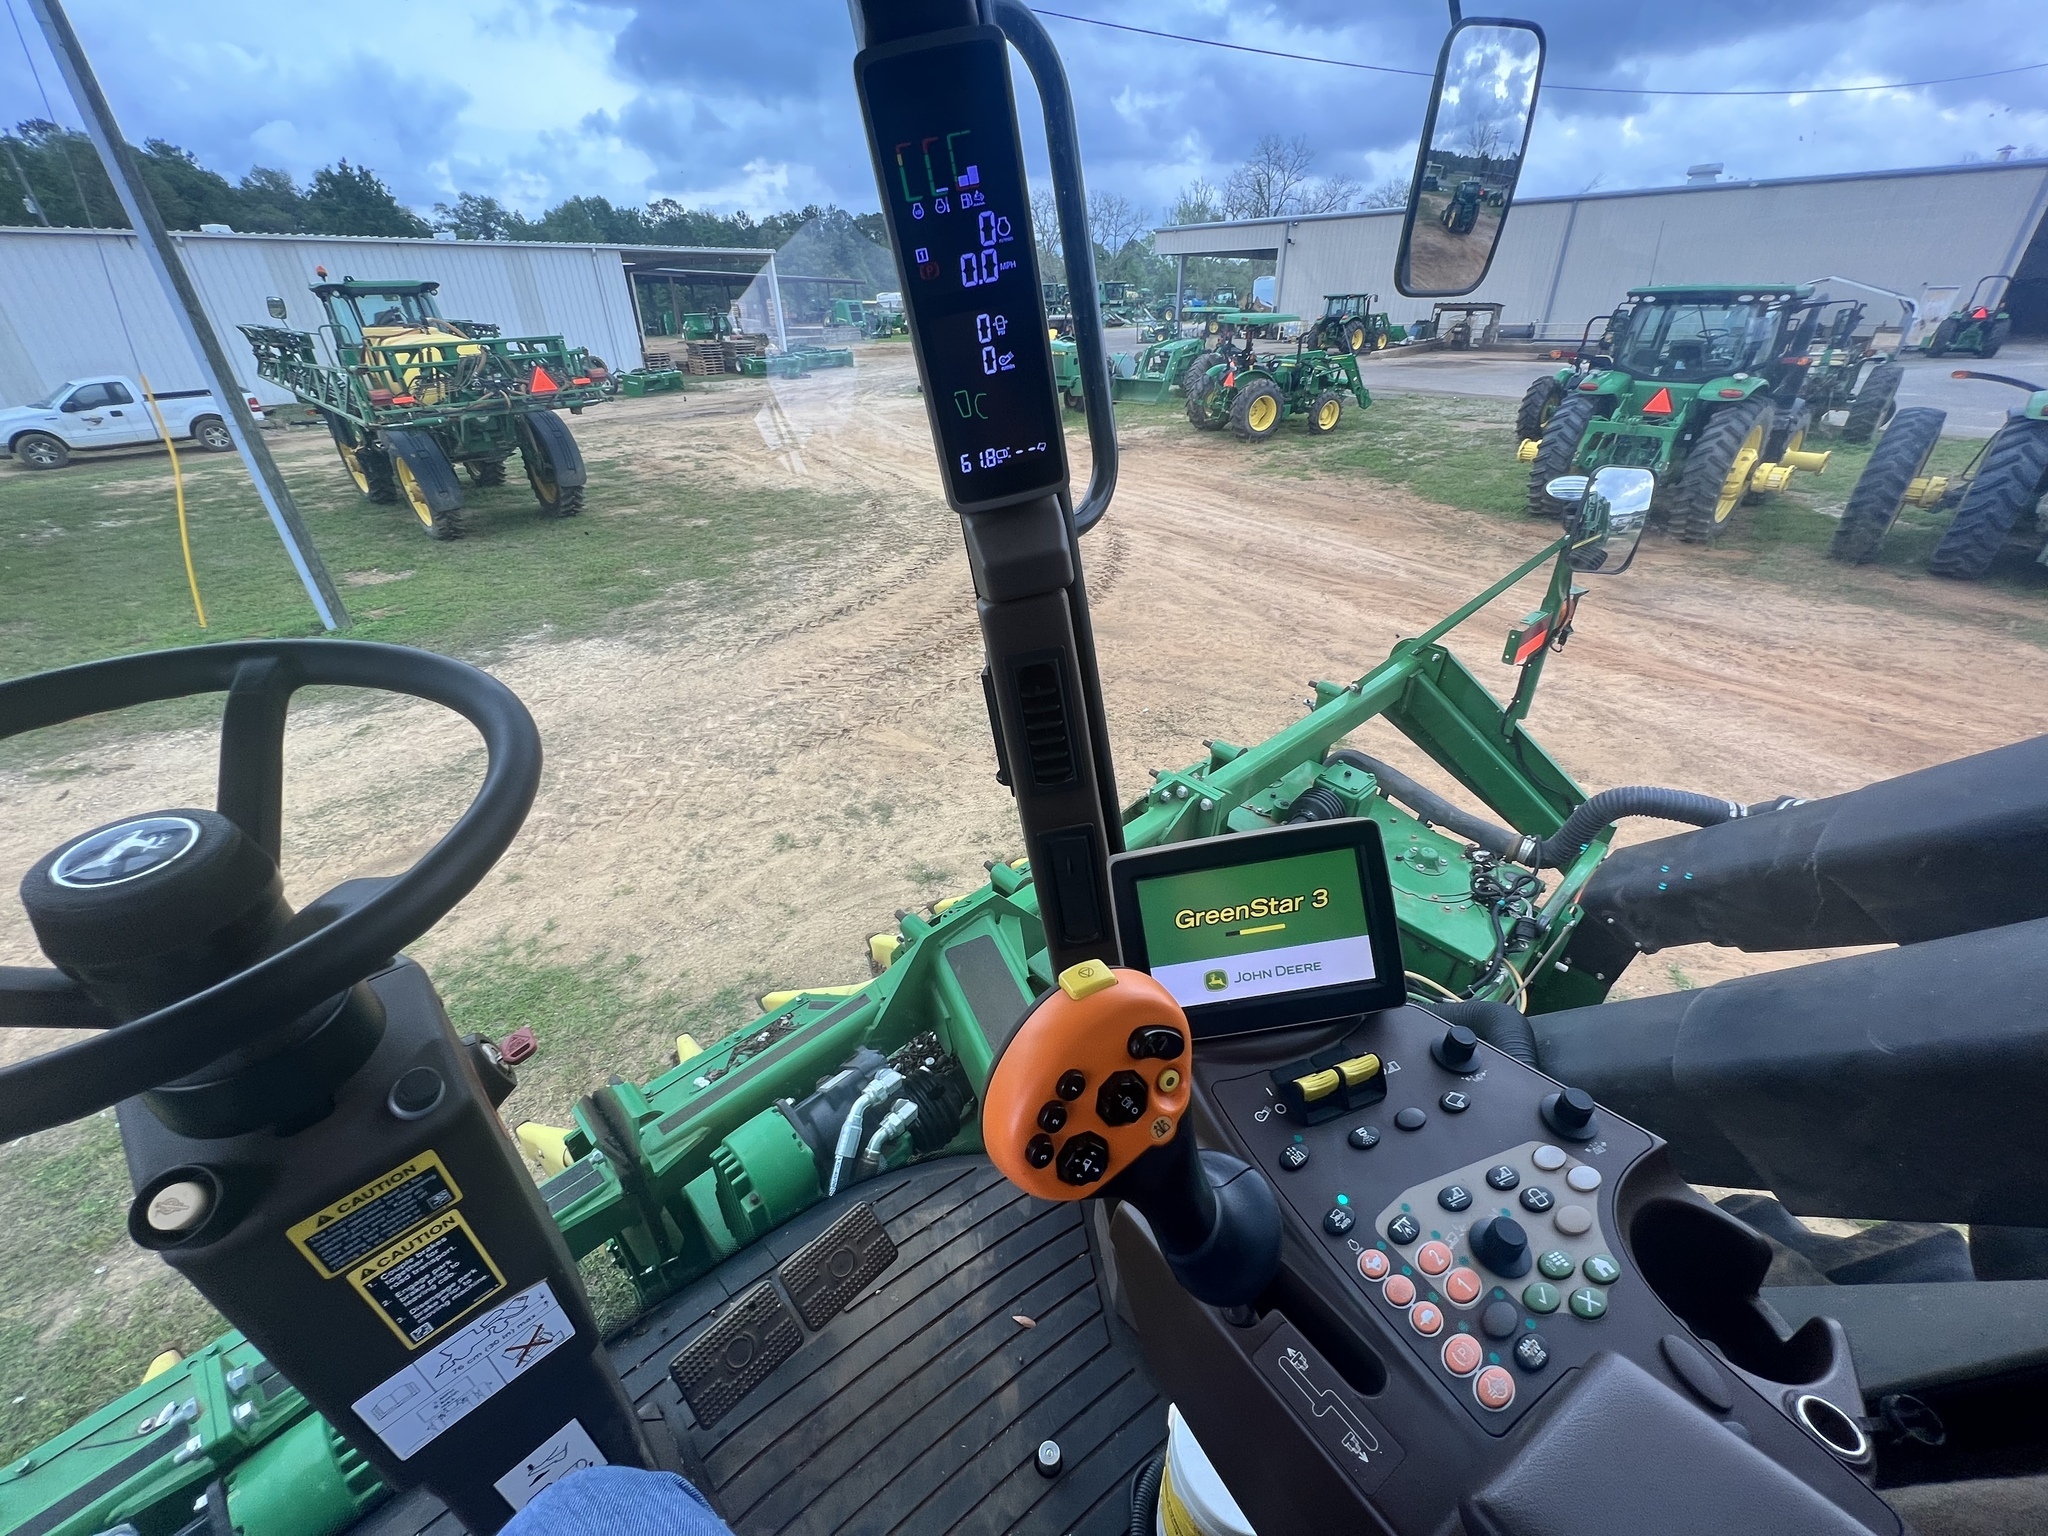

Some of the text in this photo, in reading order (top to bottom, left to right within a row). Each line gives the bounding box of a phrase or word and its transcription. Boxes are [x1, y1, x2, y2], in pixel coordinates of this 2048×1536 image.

[979, 211, 996, 246] 0
[960, 248, 1016, 288] 0.0 MPH
[977, 313, 992, 344] 0
[983, 346, 997, 375] 0
[1174, 887, 1329, 930] GreenStar 3
[1234, 961, 1322, 984] JOHN DEERE
[337, 1165, 416, 1213] CAUTION
[377, 1216, 455, 1267] CAUTION
[380, 1257, 414, 1279] Couple
[415, 1237, 447, 1257] brakes
[1428, 1249, 1444, 1266] 2
[384, 1248, 439, 1284] together for
[389, 1273, 411, 1289] road
[394, 1273, 430, 1297] Engage
[431, 1259, 453, 1275] park
[399, 1283, 426, 1302] brake
[427, 1268, 448, 1285] prior
[402, 1284, 437, 1306] leaving
[409, 1282, 457, 1314] Disengage
[457, 1268, 478, 1283] park
[413, 1300, 439, 1318] brake
[440, 1285, 461, 1302] prior
[1456, 1277, 1473, 1292] 1
[417, 1300, 451, 1323] moving
[451, 1364, 465, 1374] 76
[466, 1352, 483, 1364] cm
[516, 1314, 536, 1328] max
